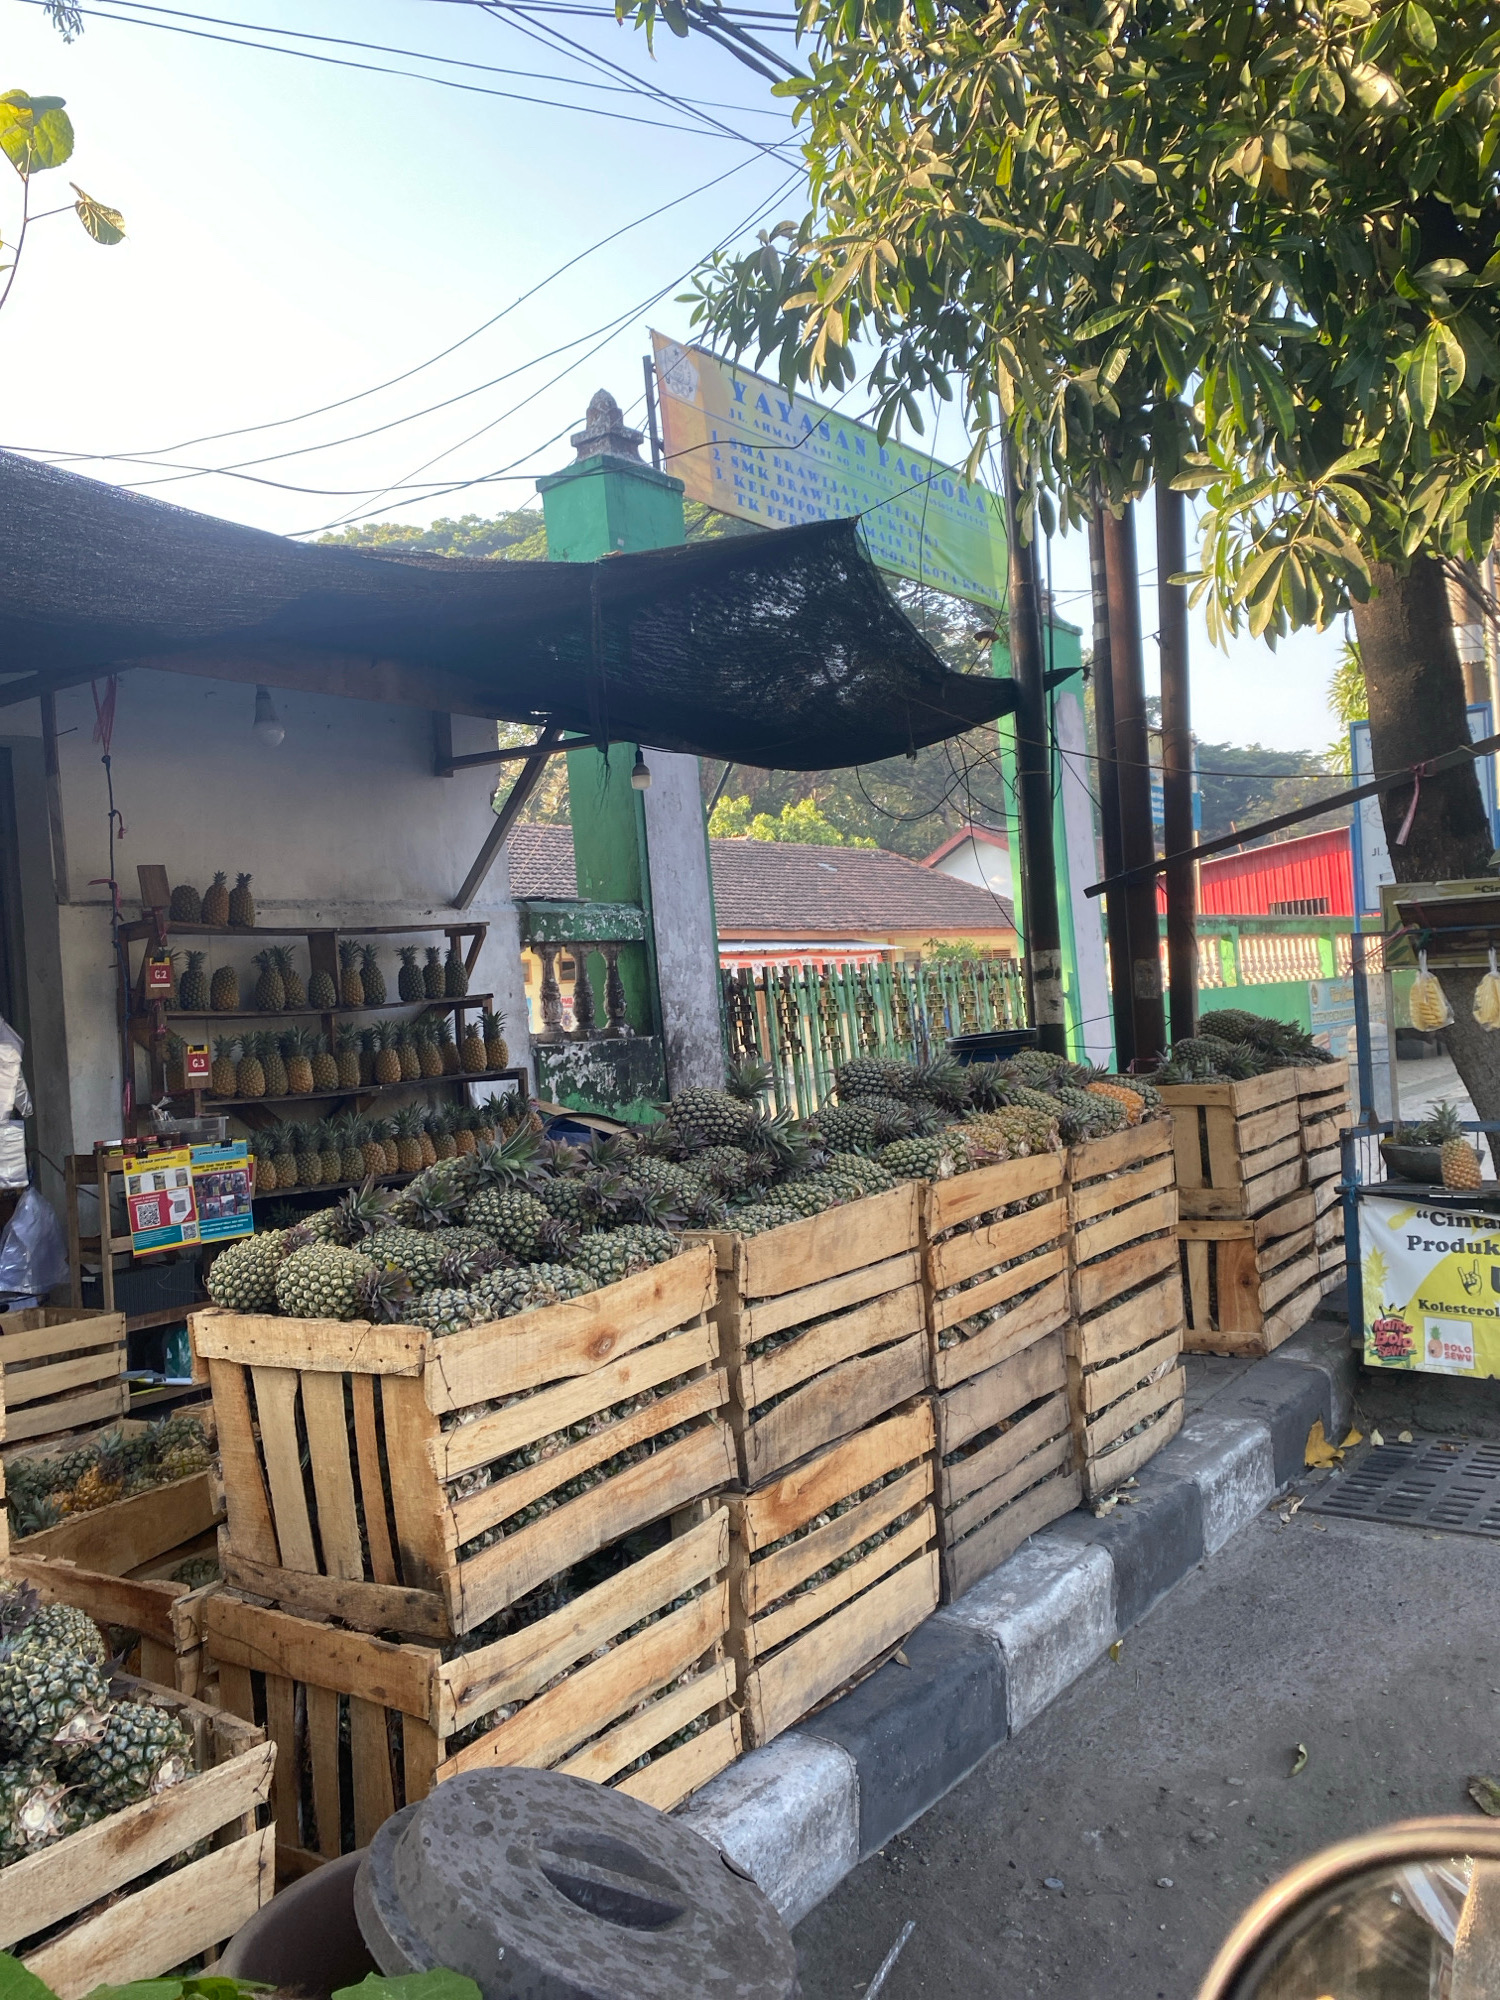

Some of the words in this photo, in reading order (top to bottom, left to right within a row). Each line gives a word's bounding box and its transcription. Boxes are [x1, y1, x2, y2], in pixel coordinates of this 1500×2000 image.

[728, 377, 864, 456] YAYASAN
[878, 446, 986, 514] PAGGORA
[728, 437, 766, 463] SMA
[773, 454, 870, 505] BRAWIJAYA
[712, 447, 725, 463] 2.
[730, 456, 769, 482] SMK
[776, 473, 873, 522] BRAWIJAYA
[733, 474, 829, 520] KELOMPOK
[734, 492, 760, 513] TK
[1406, 1234, 1500, 1256] Produk
[1418, 1299, 1500, 1318] Kolesterol
[1375, 1331, 1413, 1348] Bolo
[1443, 1343, 1472, 1354] BOLO
[1444, 1351, 1472, 1362] SEWU
